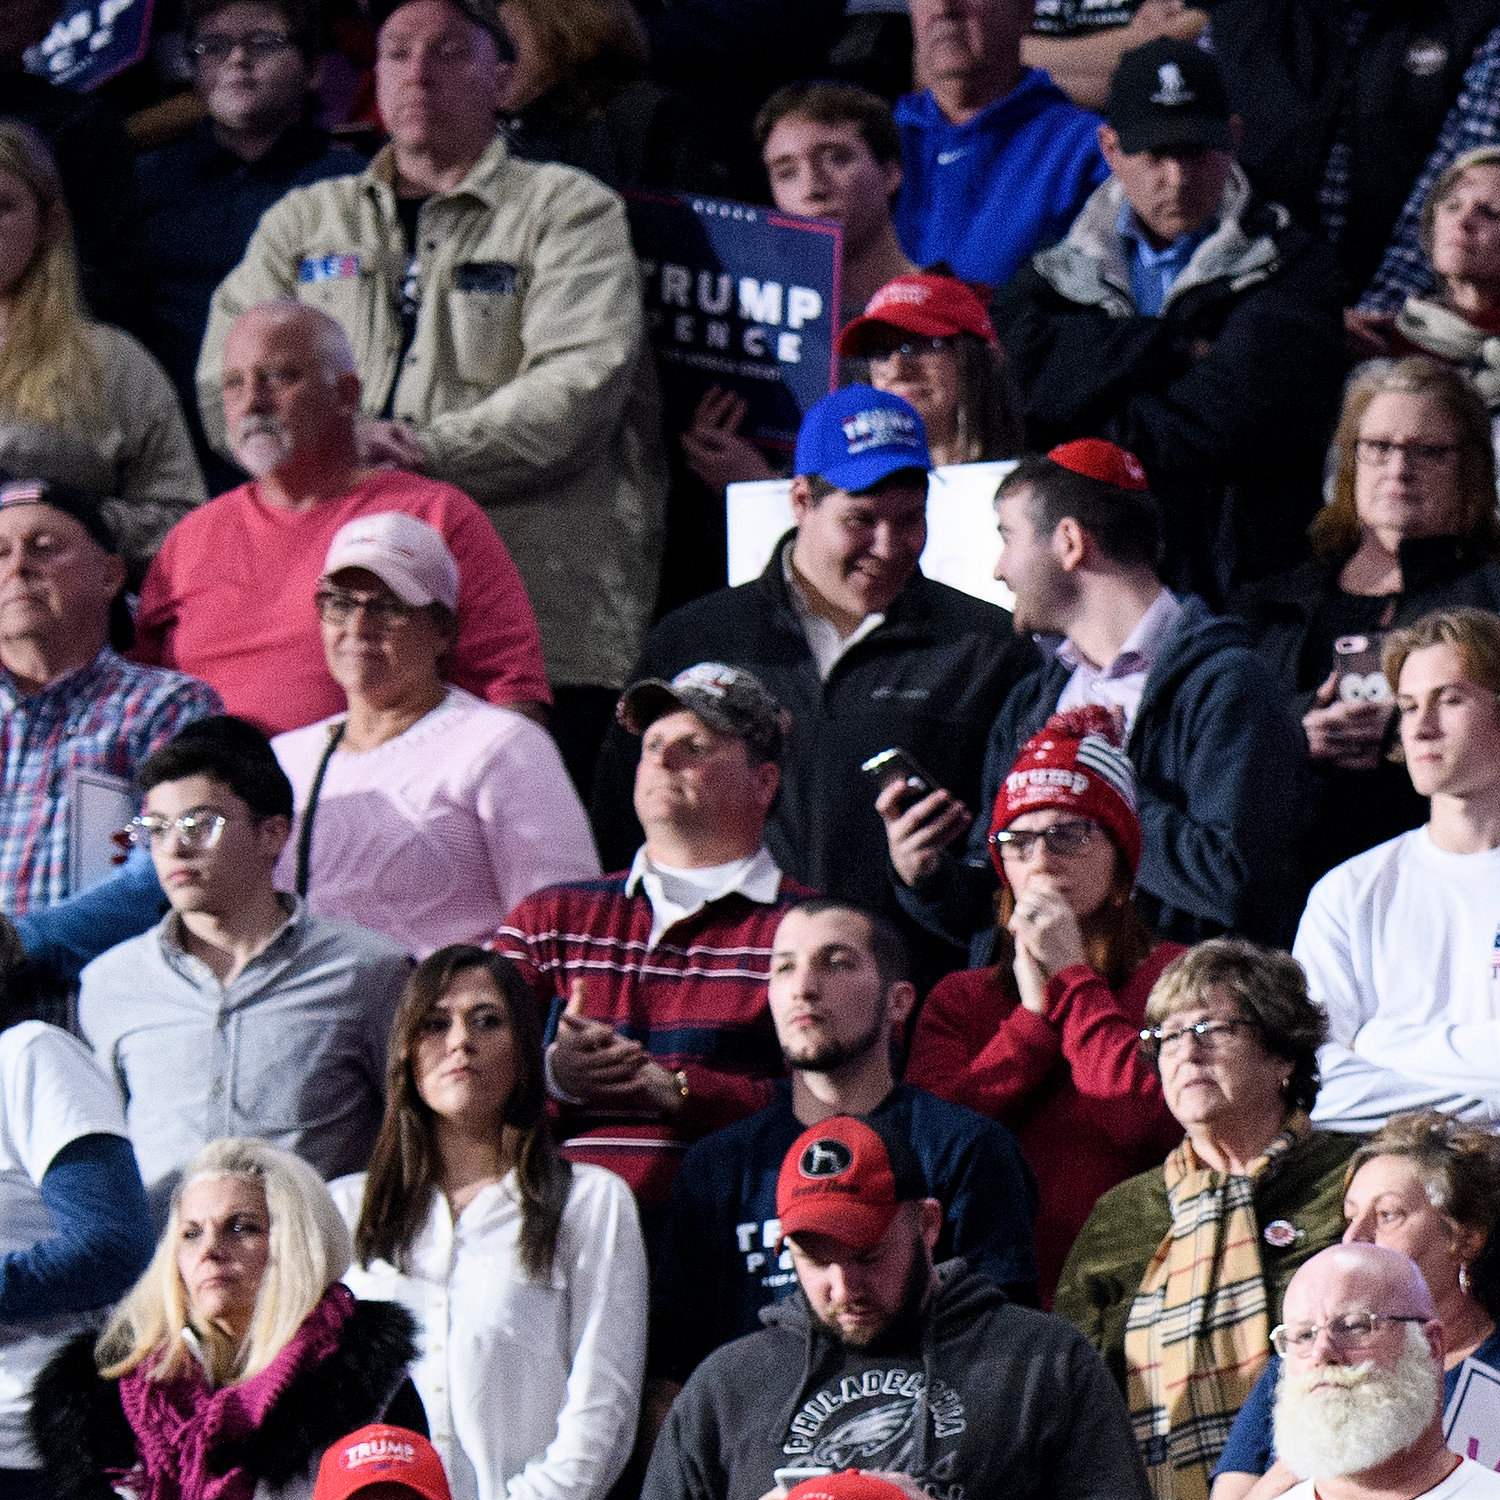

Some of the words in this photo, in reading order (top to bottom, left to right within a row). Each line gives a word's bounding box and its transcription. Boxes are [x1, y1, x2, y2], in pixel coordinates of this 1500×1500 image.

[670, 313, 802, 363] ENCE
[1006, 768, 1089, 801] Trump
[346, 1440, 415, 1460] TRUMP
